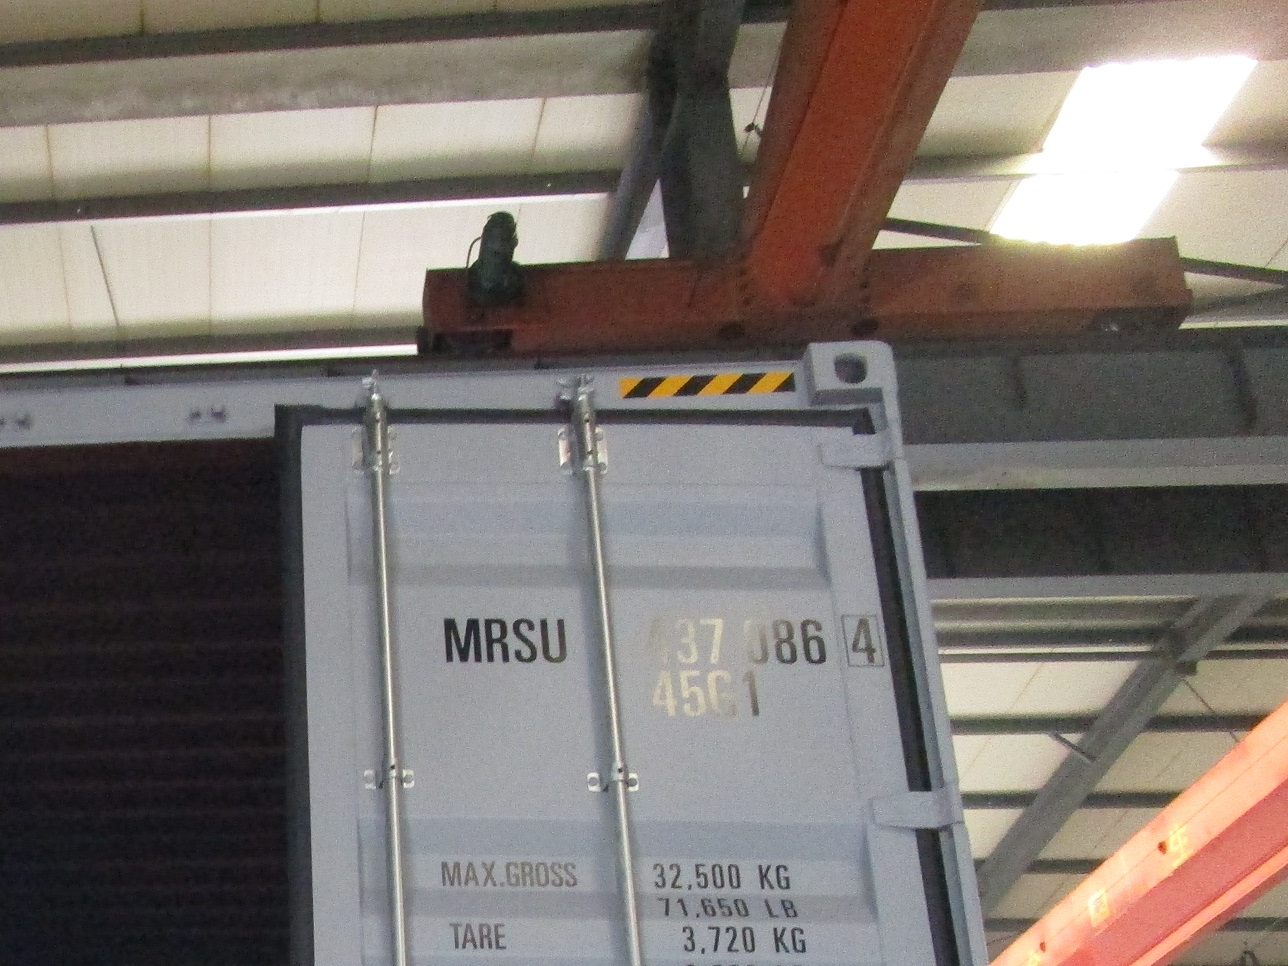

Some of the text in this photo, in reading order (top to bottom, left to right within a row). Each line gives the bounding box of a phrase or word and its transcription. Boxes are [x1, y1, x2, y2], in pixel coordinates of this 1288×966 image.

[443, 618, 568, 664] MRSU
[851, 617, 877, 664] 4
[653, 863, 742, 891] 32,500
[758, 864, 792, 890] KG
[658, 897, 799, 919] 71,650 LB
[449, 922, 808, 955] TARE 3,720 KG
